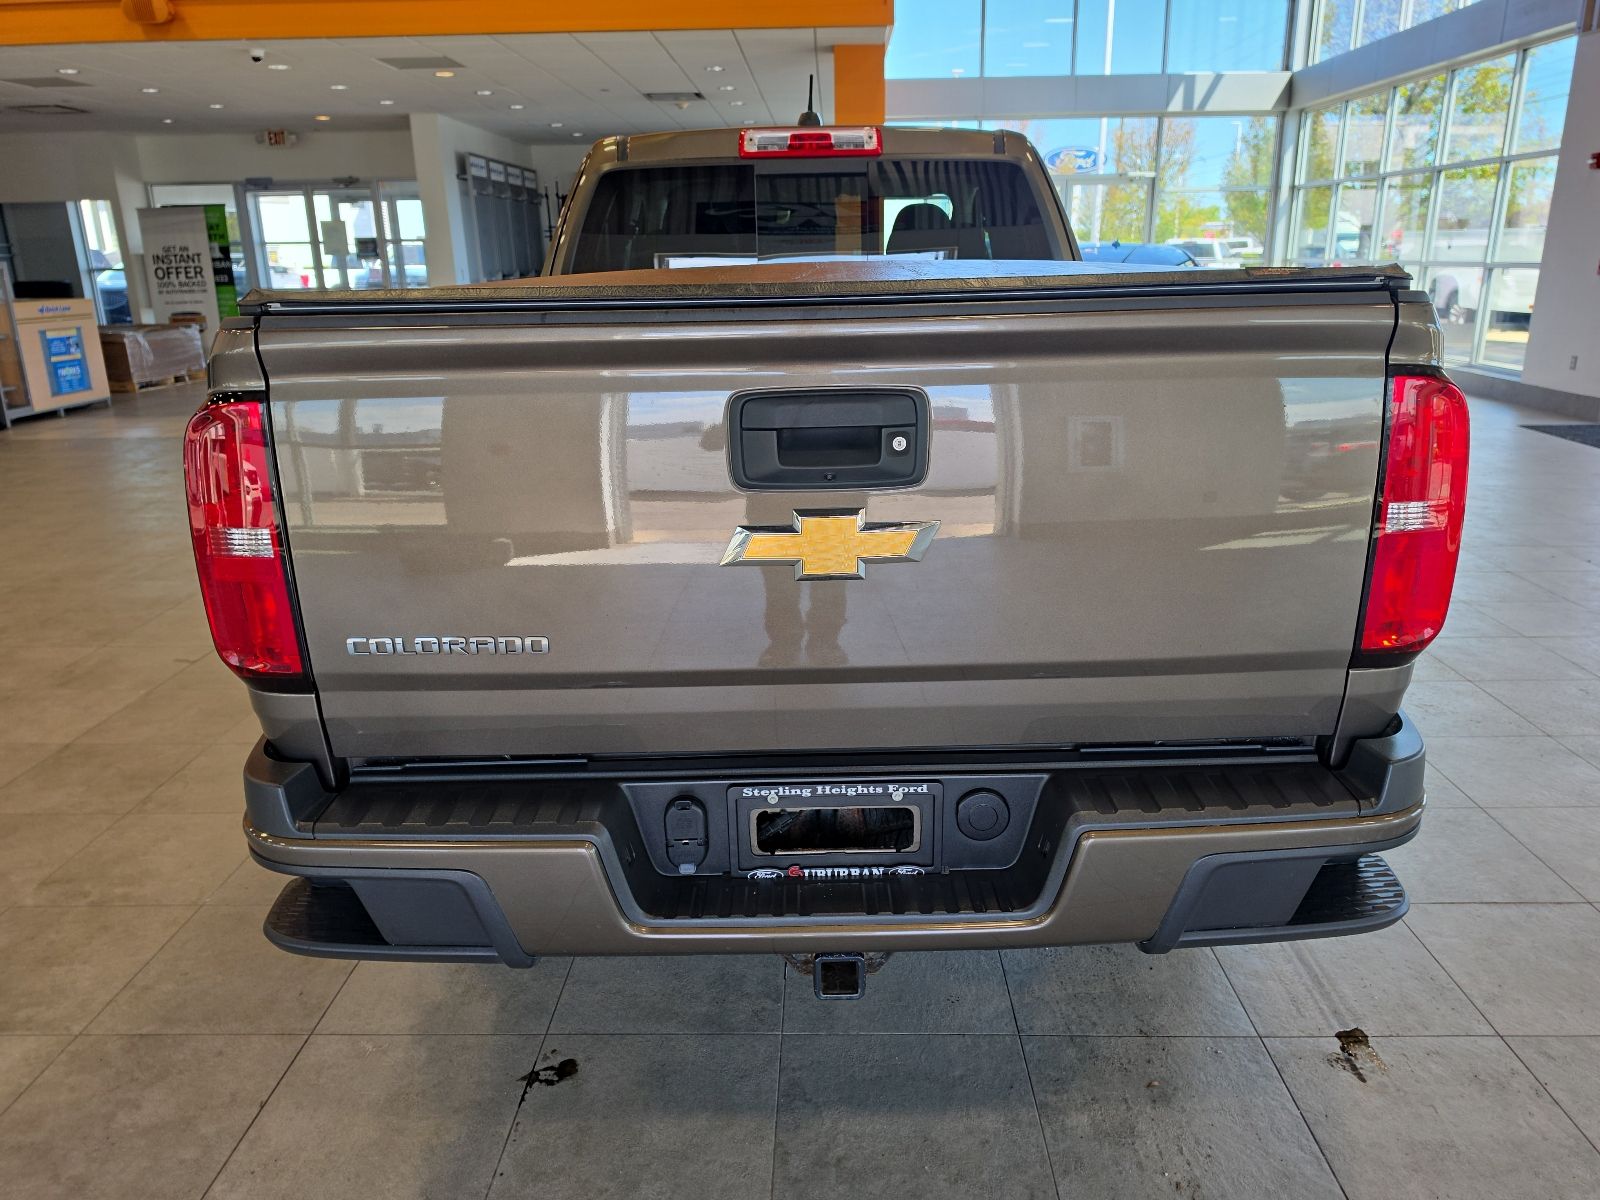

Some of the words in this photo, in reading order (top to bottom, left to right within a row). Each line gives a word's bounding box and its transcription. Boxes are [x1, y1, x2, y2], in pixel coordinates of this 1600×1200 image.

[152, 253, 202, 265] INSTANT
[154, 265, 204, 280] OFFER
[178, 280, 207, 288] BACKED
[346, 636, 550, 656] COLORADO
[742, 786, 812, 797] Sterling
[816, 785, 883, 796] Heights
[887, 784, 929, 794] Ford
